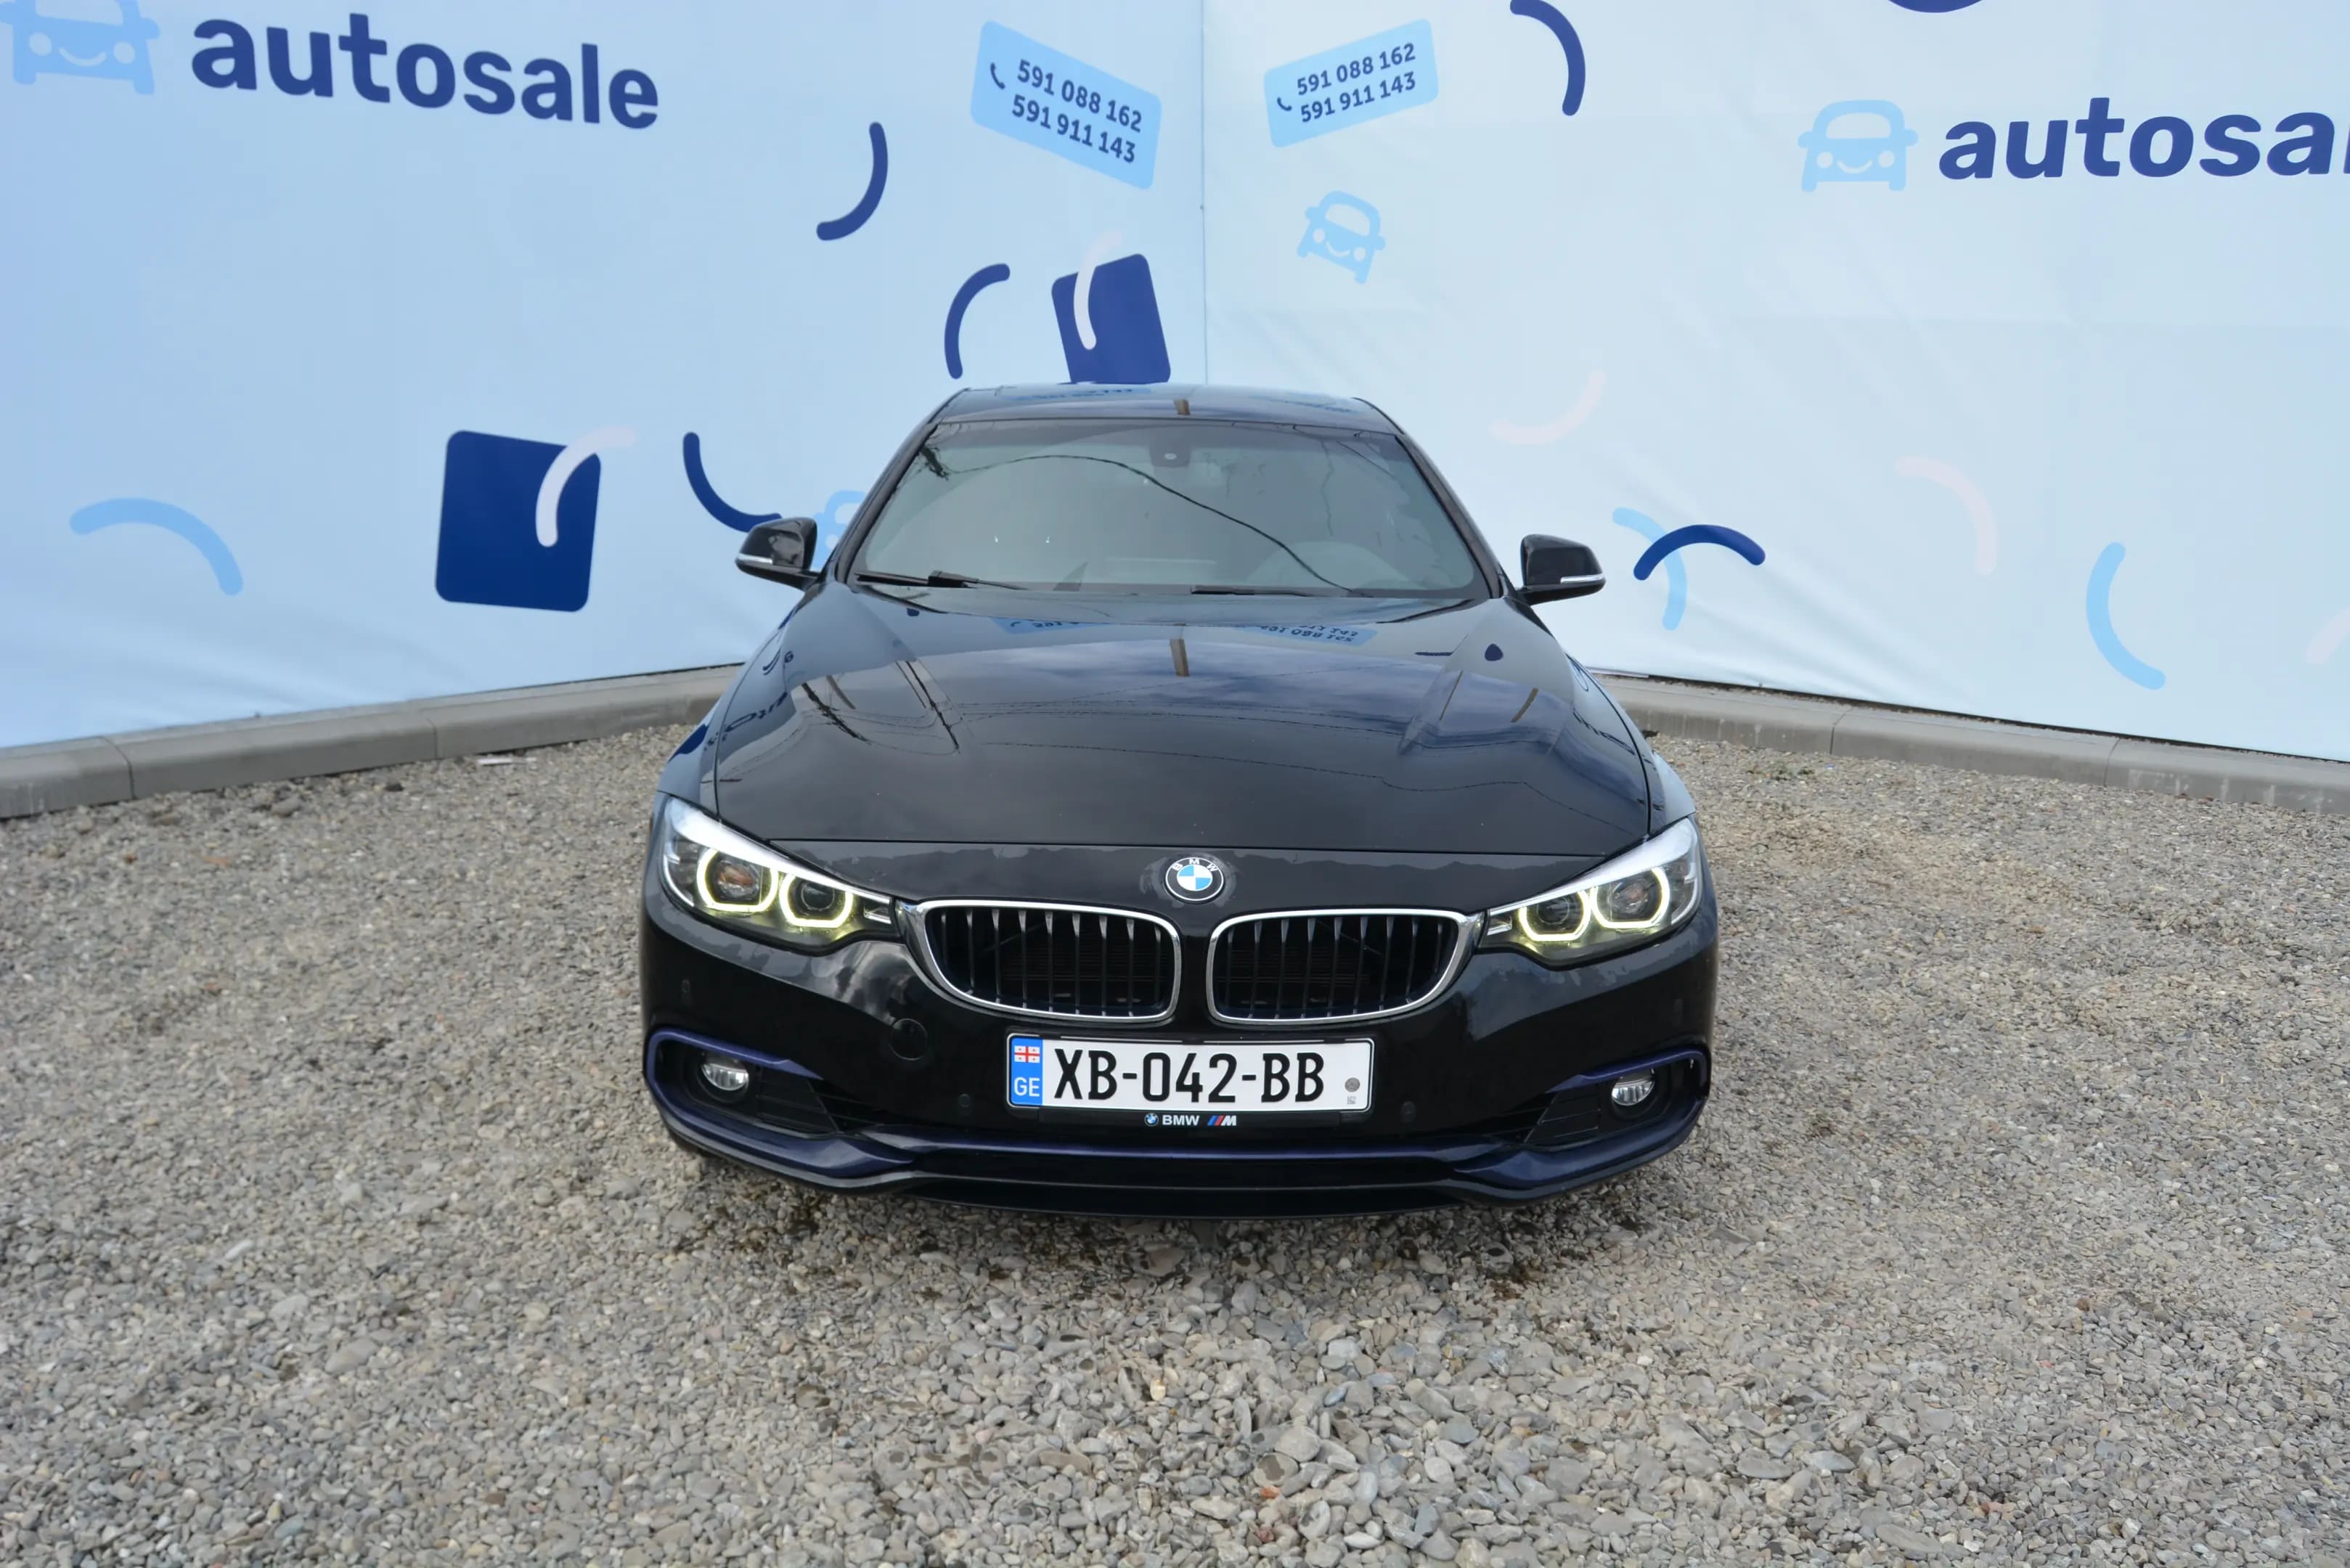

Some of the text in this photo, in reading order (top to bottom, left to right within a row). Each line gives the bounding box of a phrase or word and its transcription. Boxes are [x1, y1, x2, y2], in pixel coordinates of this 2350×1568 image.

[191, 12, 658, 129] autosale
[1017, 59, 1142, 133] 591 088 162
[1297, 43, 1416, 96] 591 088 162
[1301, 71, 1416, 123] 591 911 143
[1012, 94, 1135, 163] 591 911 143
[1938, 97, 2350, 180] autosa
[1171, 858, 1218, 873] BMW
[1013, 1077, 1040, 1097] GE
[1054, 1048, 1324, 1103] XB-042-BB
[1162, 1115, 1200, 1126] BMW
